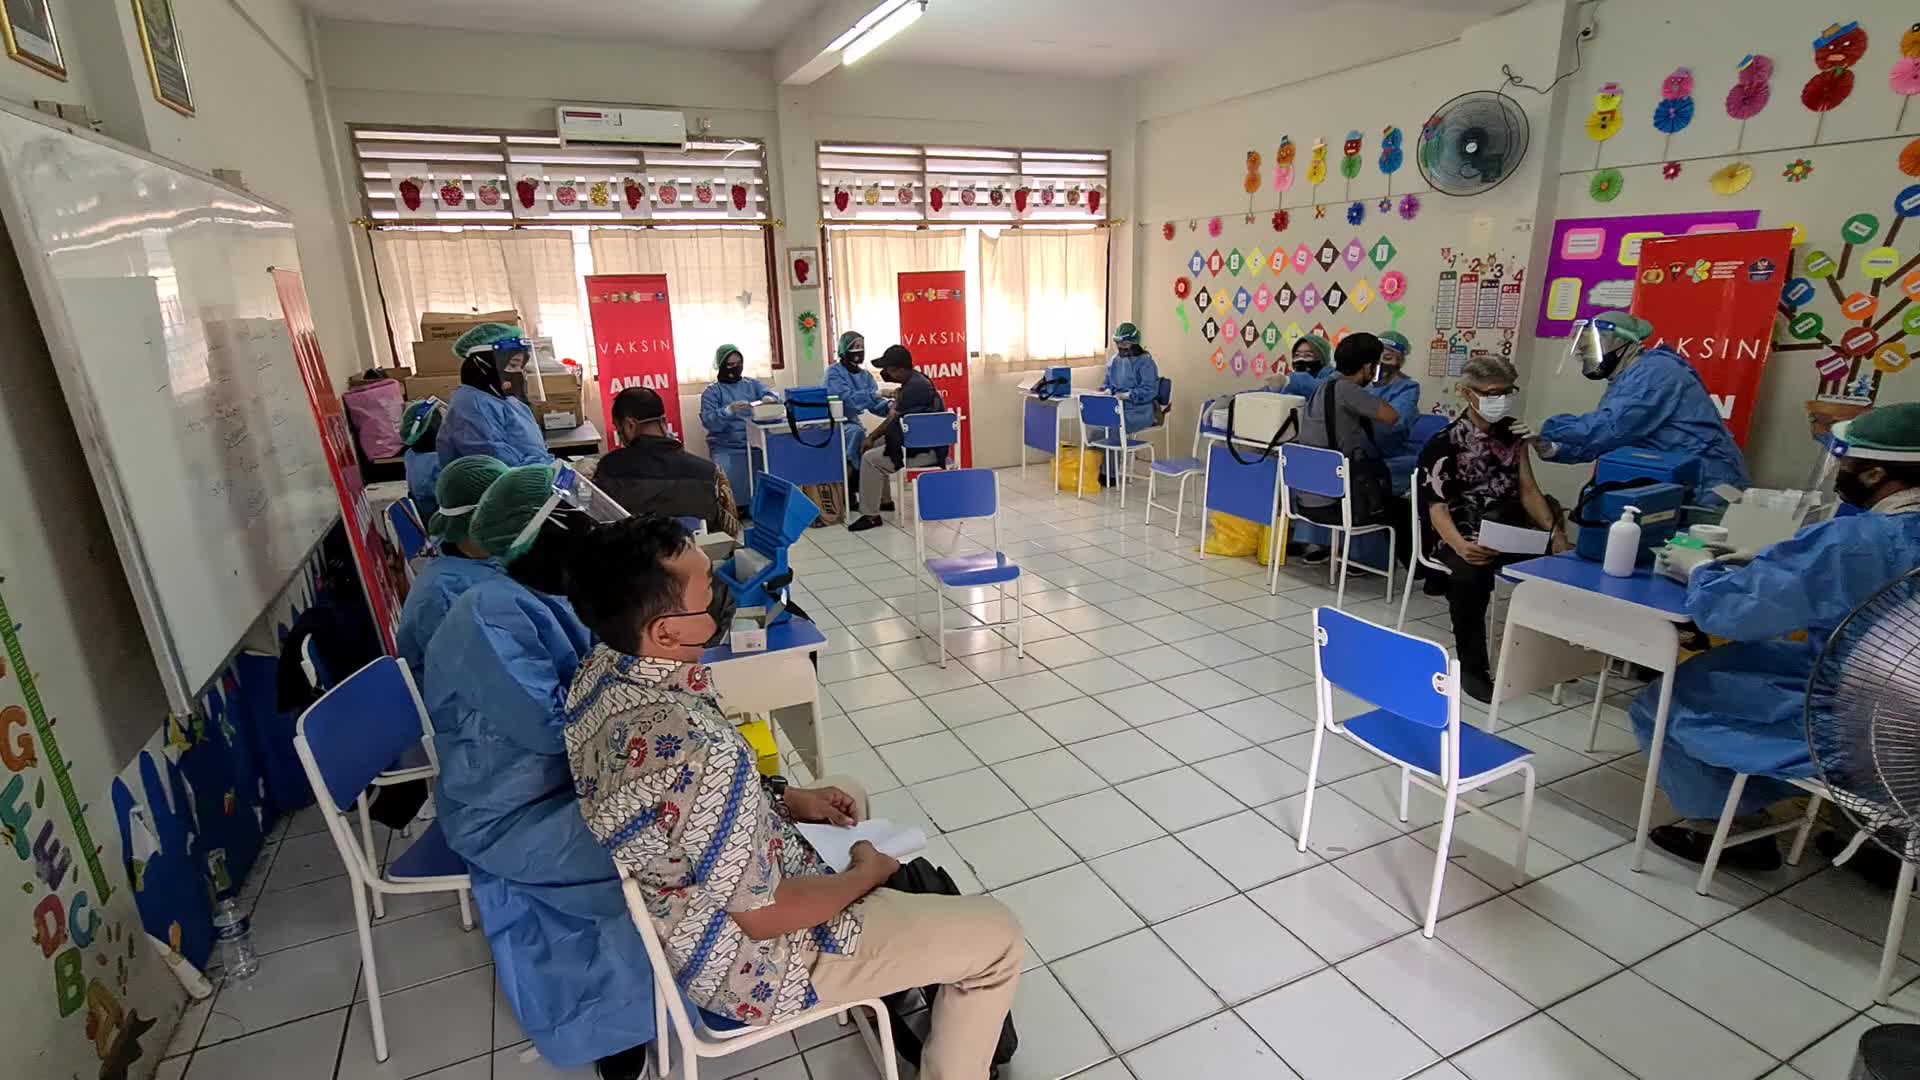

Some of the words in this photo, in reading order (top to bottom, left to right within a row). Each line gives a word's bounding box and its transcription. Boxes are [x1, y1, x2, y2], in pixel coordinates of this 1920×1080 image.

[1471, 258, 1481, 273] 2
[1493, 264, 1503, 279] 3
[1514, 269, 1523, 285] 4
[903, 331, 967, 346] VAKSIN
[1449, 333, 1457, 346] 6
[599, 339, 671, 355] VAKSIN
[1502, 341, 1512, 356] 8
[610, 373, 670, 394] AMAN
[0, 704, 37, 773] G
[33, 818, 71, 892] E
[33, 893, 67, 960] D
[68, 890, 97, 950] C
[55, 946, 86, 1019] B
